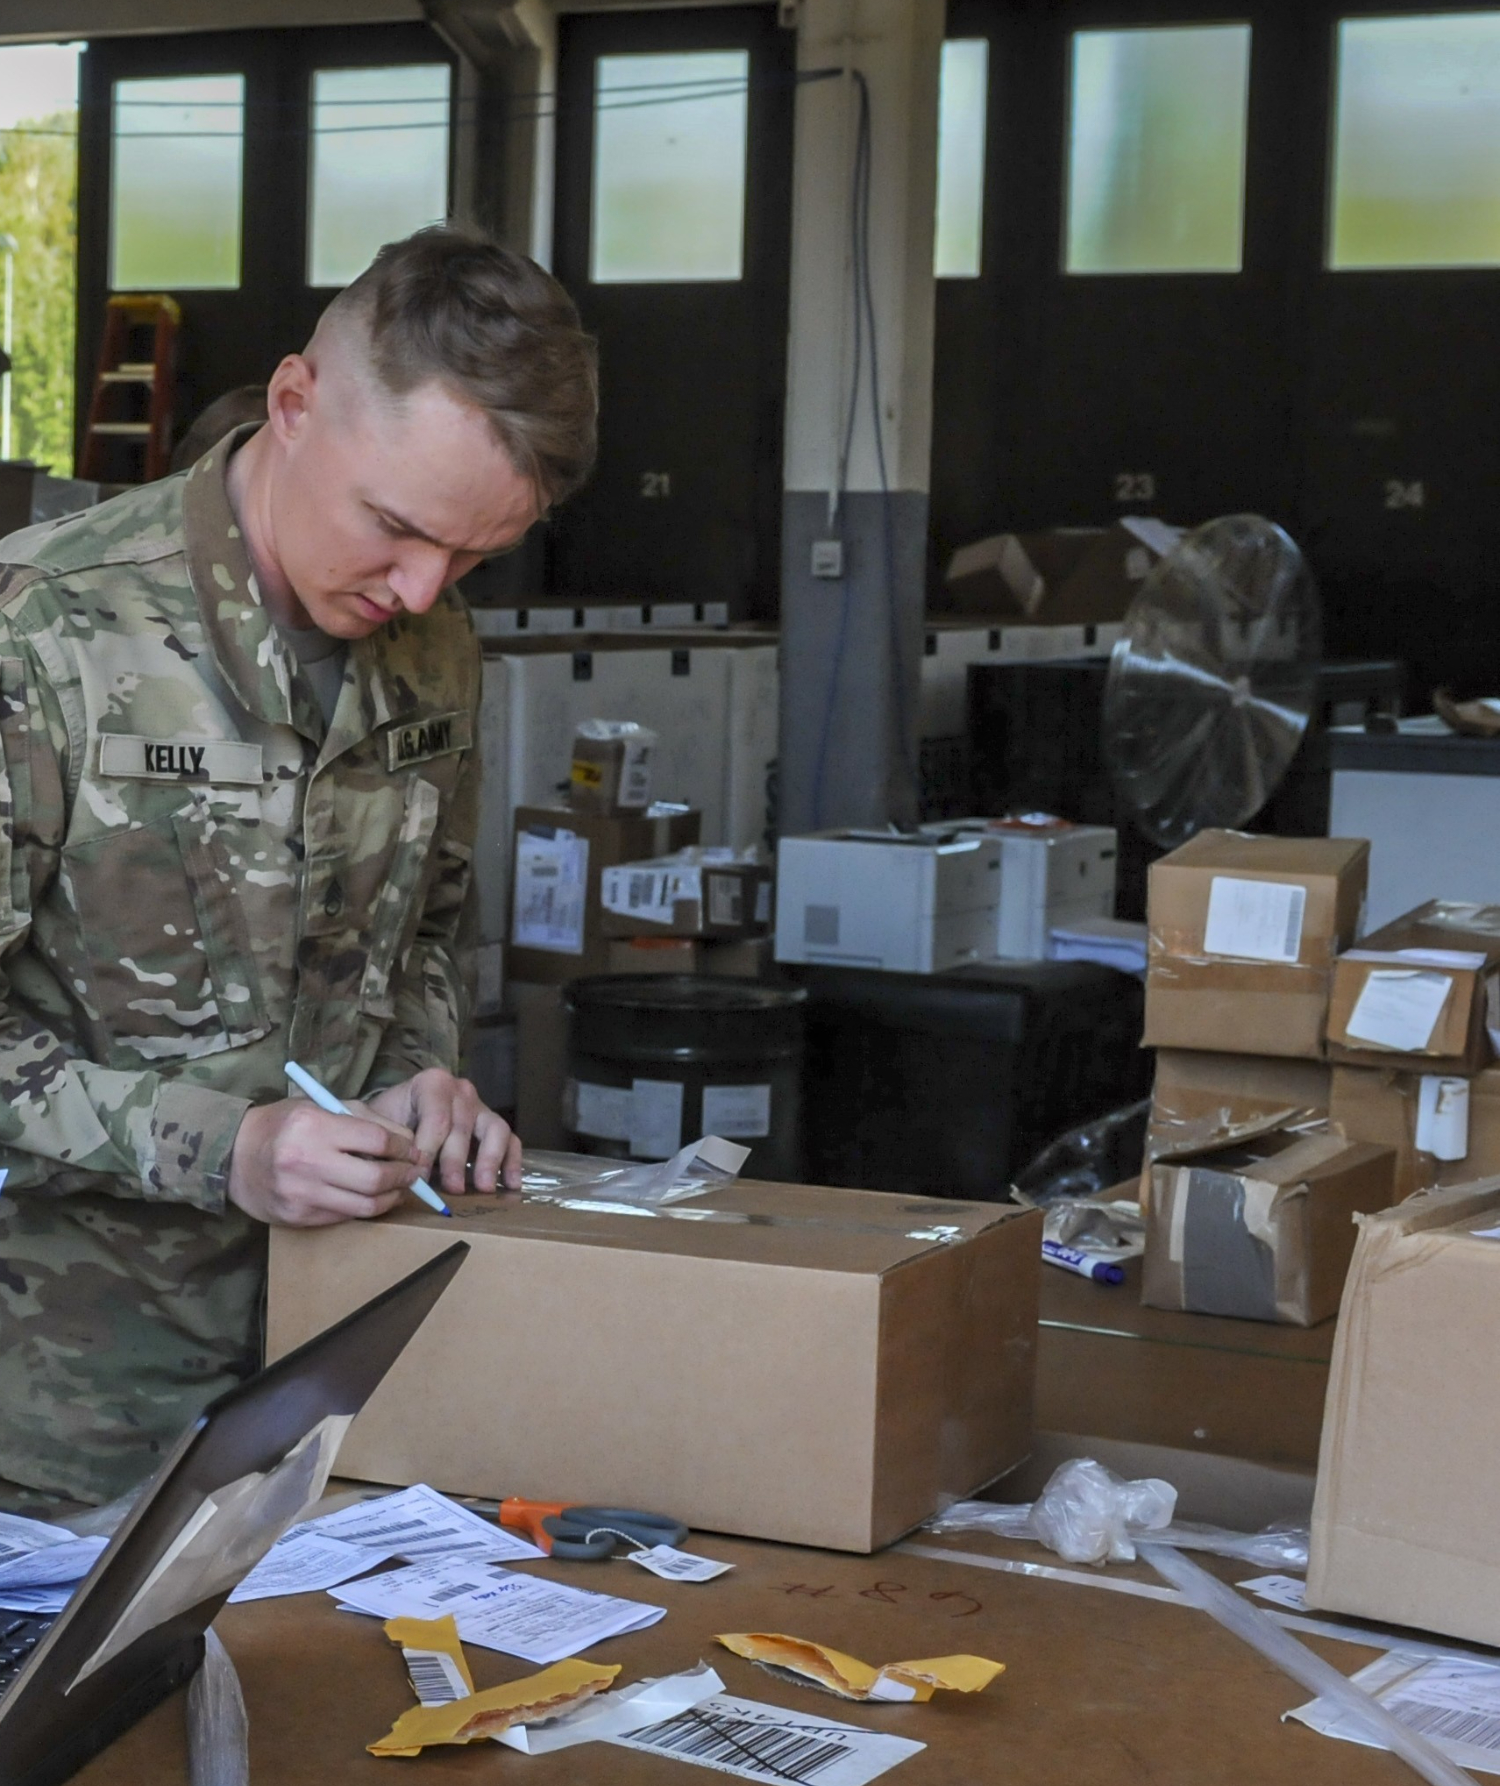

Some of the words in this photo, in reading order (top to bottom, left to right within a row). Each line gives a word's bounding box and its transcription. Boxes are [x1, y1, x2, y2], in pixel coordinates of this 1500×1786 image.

[641, 472, 670, 497] 21
[1114, 472, 1154, 501] 23
[1384, 480, 1425, 509] 24
[144, 743, 205, 774] KELLY
